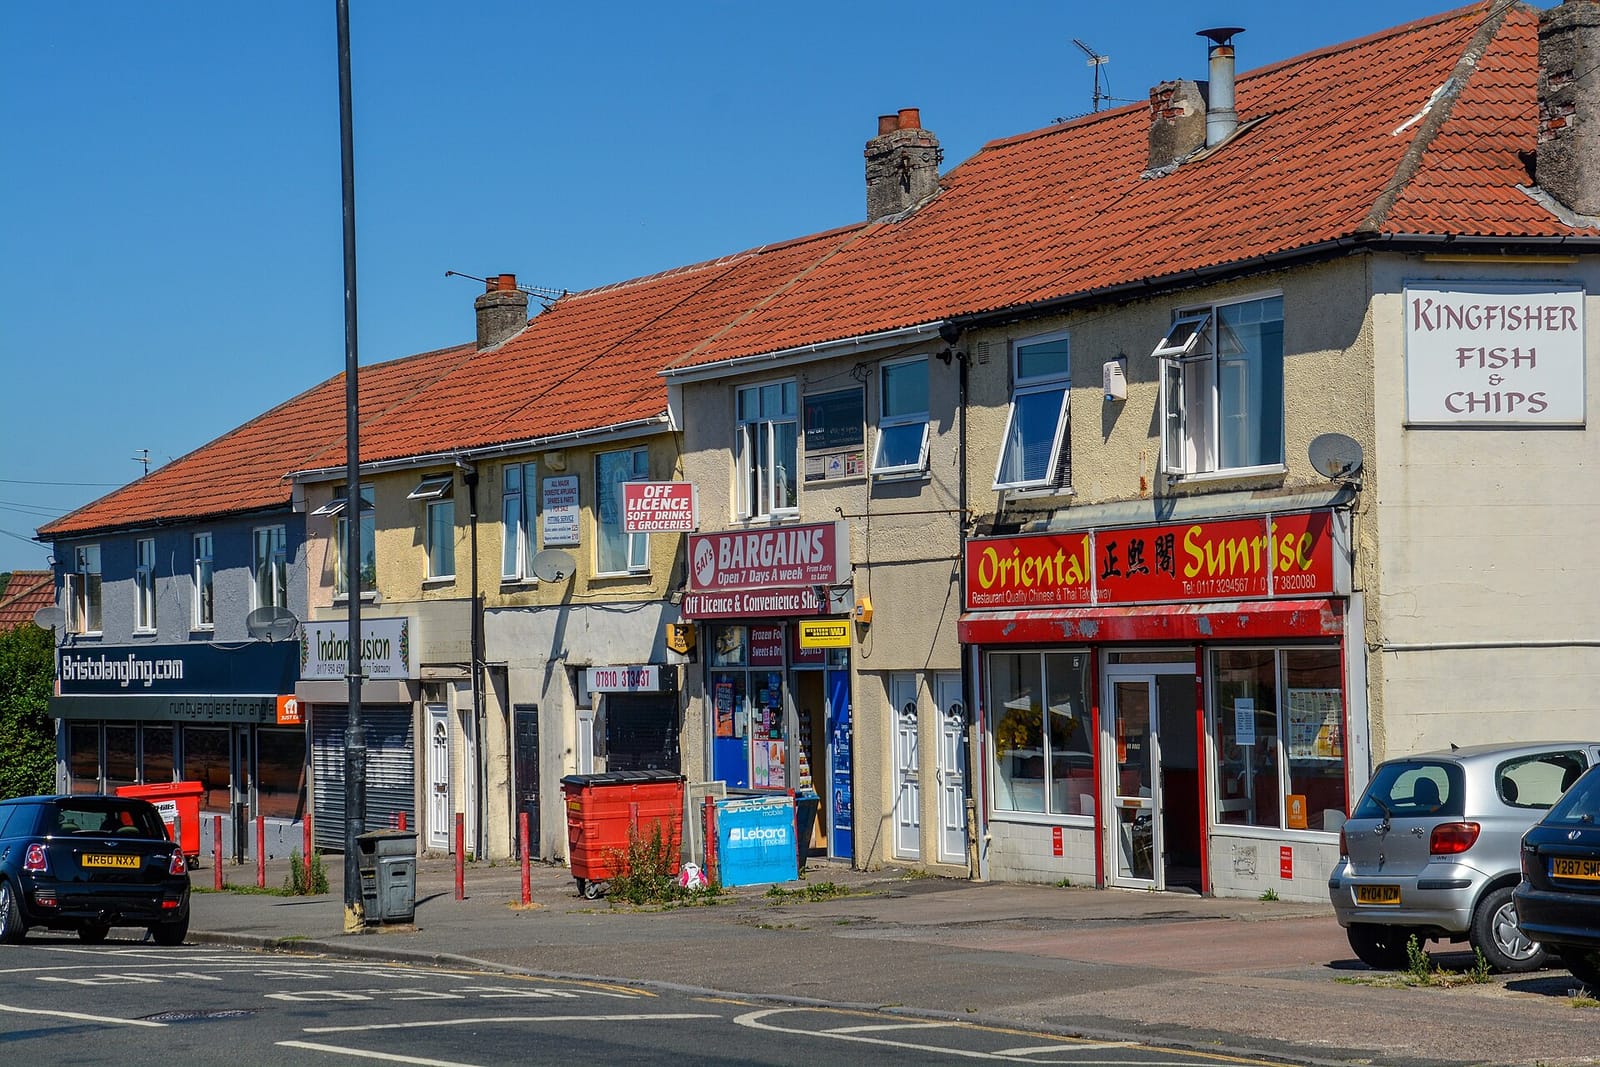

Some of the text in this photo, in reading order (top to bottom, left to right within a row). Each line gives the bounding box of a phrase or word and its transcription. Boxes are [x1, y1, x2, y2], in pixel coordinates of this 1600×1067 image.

[1413, 298, 1578, 331] KINGFISHER
[1456, 347, 1536, 369] FISH
[1489, 374, 1504, 385] &
[1445, 392, 1548, 413] CHIPS
[644, 486, 672, 497] OFF
[628, 498, 688, 510] LICENCE
[628, 511, 691, 520] SOFT DRINKS
[638, 521, 691, 529] GROCERIES
[718, 529, 823, 569] BARGAINS
[1184, 522, 1312, 577] Sunrise
[819, 564, 832, 572] Early
[978, 534, 1090, 589] Oriental
[718, 567, 802, 586] Open 7 Days A week
[1182, 581, 1195, 594] Tel:
[1197, 580, 1214, 594] 0117
[1216, 578, 1248, 593] 3294567
[1261, 576, 1279, 591] 07
[1281, 574, 1316, 590] 3820080
[686, 591, 825, 614] Off Licence & Convenience Shop
[972, 591, 1004, 604] Restaurant
[1006, 590, 1028, 604] Quality
[1029, 589, 1054, 601] Chinese
[1056, 589, 1061, 600] &
[1063, 587, 1077, 600] Thai
[752, 630, 772, 641] Frozen
[316, 630, 390, 661] Indian usion
[752, 646, 768, 657] Sweets
[63, 654, 183, 687] Bristolangling.com
[596, 670, 650, 687] 07810 373437
[742, 827, 785, 839] Lebara
[87, 855, 136, 865] WR60 NXX
[1555, 861, 1580, 874] Y287
[1361, 888, 1380, 900] RY04
